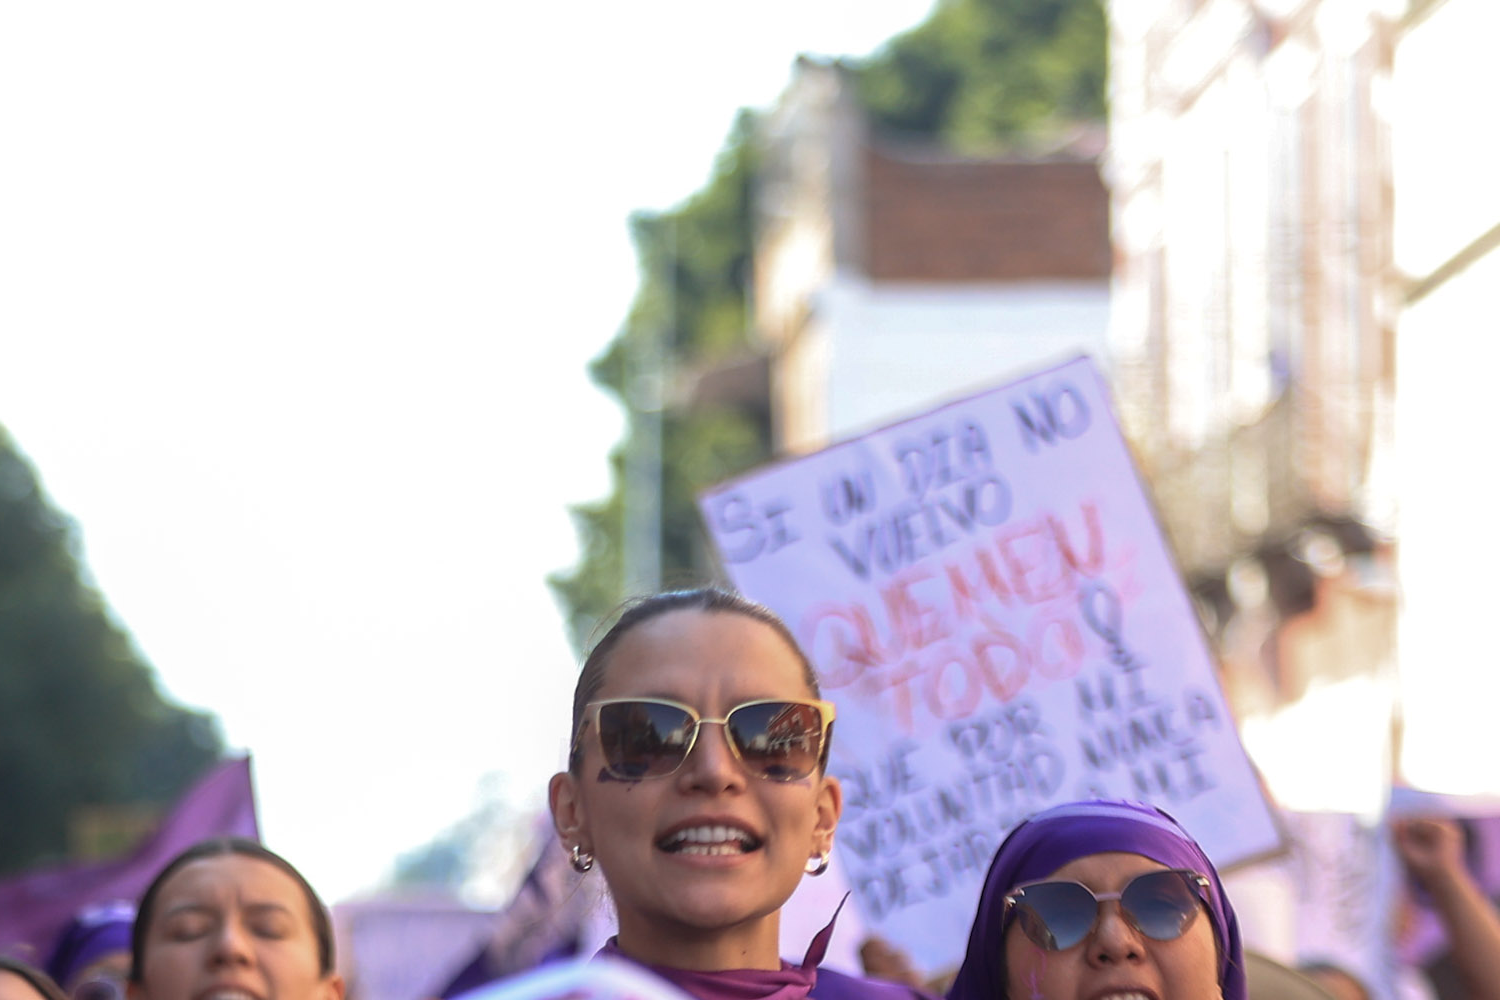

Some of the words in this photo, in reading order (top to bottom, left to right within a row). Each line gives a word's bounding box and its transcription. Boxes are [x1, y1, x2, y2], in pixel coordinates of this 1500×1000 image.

[718, 490, 804, 564] SI
[1009, 381, 1093, 455] NO
[855, 610, 1088, 738] TODO
